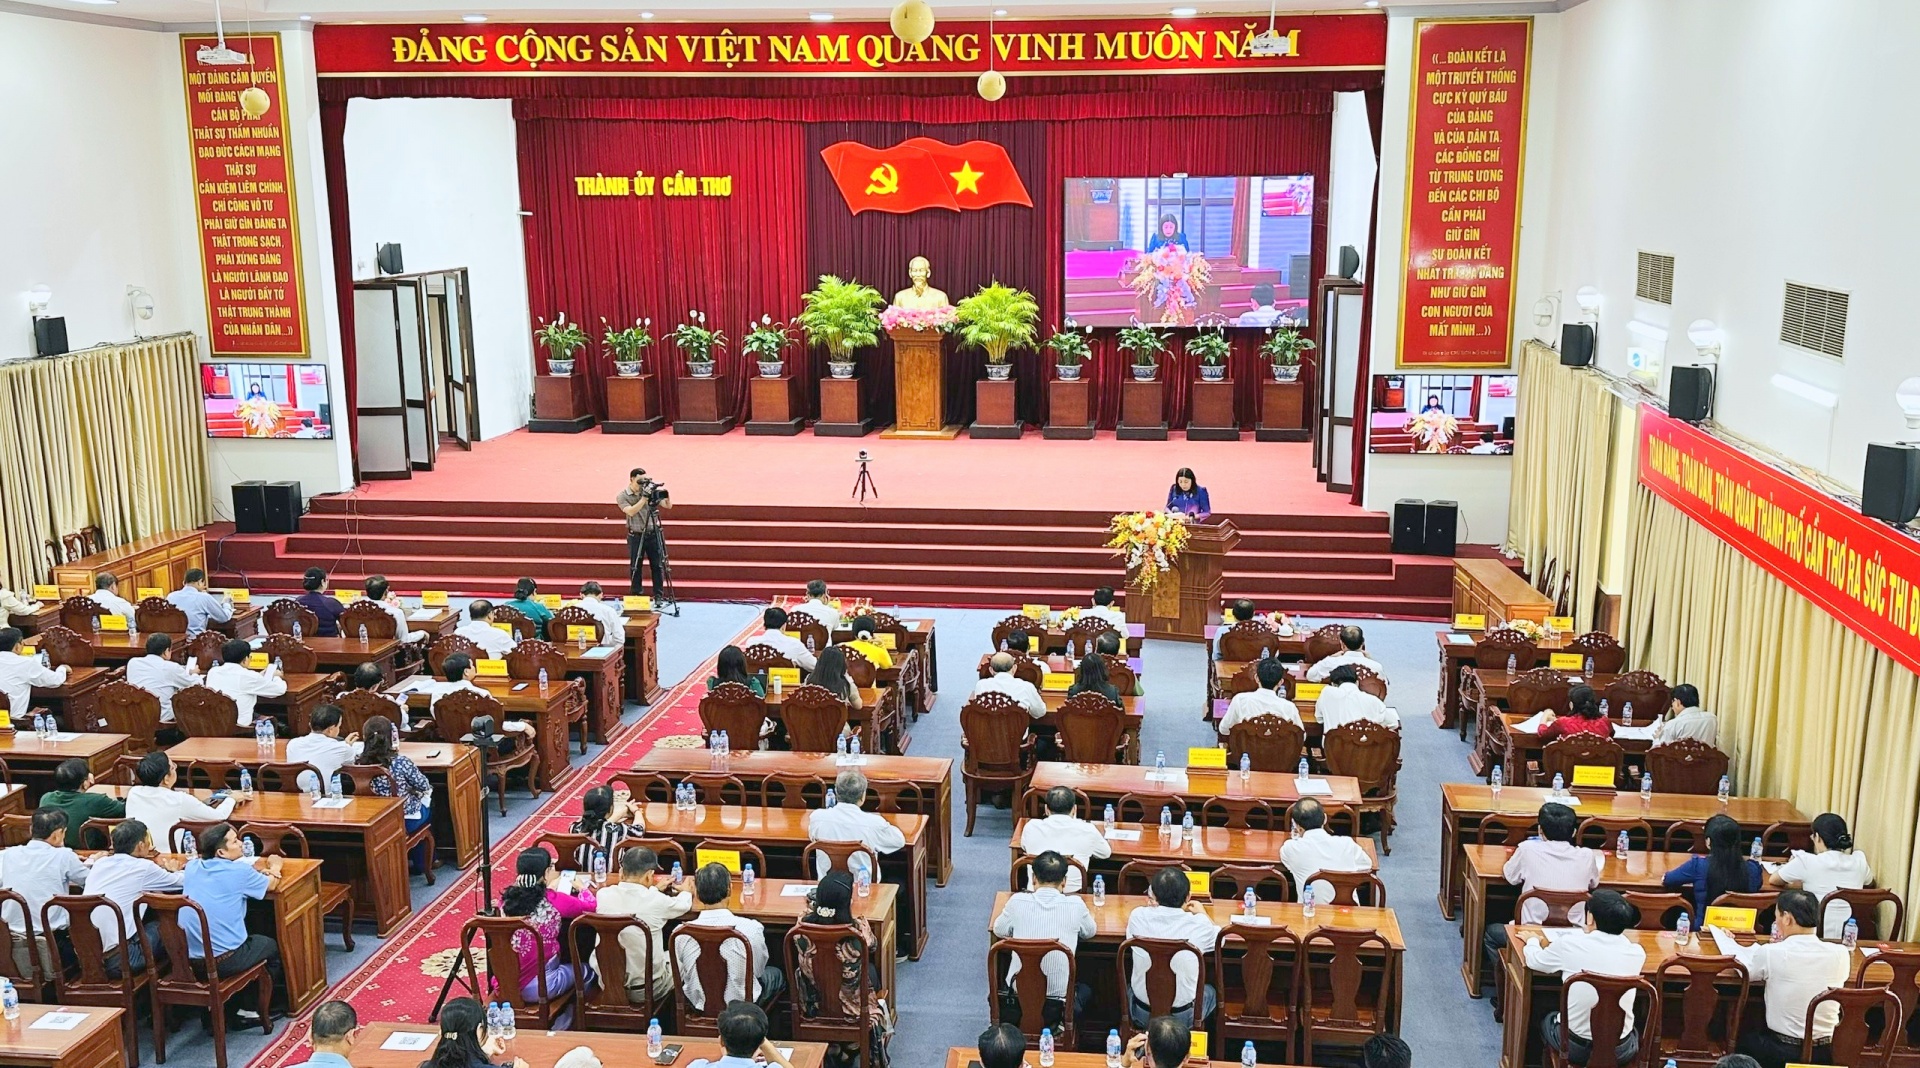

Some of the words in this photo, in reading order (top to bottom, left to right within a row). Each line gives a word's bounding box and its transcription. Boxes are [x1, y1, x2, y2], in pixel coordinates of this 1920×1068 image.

[391, 27, 487, 63] ĐẢNG
[494, 28, 594, 68] CỘNG
[600, 26, 668, 63] SẢN
[676, 28, 762, 68] VIỆT
[768, 35, 850, 63] NAM
[856, 34, 981, 68] QUANG
[992, 33, 1086, 61] VINH
[1094, 24, 1205, 60] MUÔN
[1475, 45, 1492, 63] KẾT
[1494, 47, 1506, 63] LÀ
[189, 70, 206, 87] MỘT
[208, 68, 230, 84] ĐẢNG
[230, 67, 249, 84] CẦM
[1426, 69, 1446, 87] MỘT
[1447, 67, 1483, 85] TRUYỀN
[1486, 66, 1516, 84] THỐNG
[215, 88, 236, 102] ĐẢNG
[1433, 91, 1453, 107] CỰC
[1469, 87, 1487, 105] QUÝ
[1490, 87, 1508, 103] BÁU
[211, 107, 228, 121] CÁN
[230, 107, 240, 123] BỘ
[1447, 107, 1466, 124] CỦA
[1467, 106, 1493, 123] ĐẢNG
[194, 127, 213, 141] THẬT
[215, 128, 225, 141] SỰ
[228, 123, 250, 139] THẤM
[1433, 129, 1445, 145] VÀ
[1446, 128, 1465, 144] CỦA
[1467, 128, 1487, 143] DÂN
[199, 146, 214, 160] ĐẠO
[215, 143, 233, 158] ĐỨC
[234, 143, 255, 158] CÁCH
[257, 144, 281, 160] MẠNG
[1435, 147, 1454, 164] CÁC
[1456, 145, 1482, 163] ĐỒNG
[1483, 146, 1500, 162] CHÍ
[225, 162, 244, 178] THẬT
[245, 163, 257, 178] SỰ
[1429, 168, 1441, 184] TỪ
[1443, 170, 1474, 184] TRUNG
[1475, 169, 1503, 182] ƯƠNG
[200, 178, 216, 194] CẦN
[217, 180, 237, 196] KIỆM
[239, 180, 257, 194] LIÊM
[259, 179, 286, 194] CHÍNH,
[574, 172, 629, 196] THÀNH
[633, 170, 655, 196] ỦY
[662, 170, 698, 196] CẦN
[700, 175, 732, 196] THƠ
[1428, 186, 1447, 203] ĐẾN
[1449, 187, 1468, 202] CÁC
[1469, 189, 1486, 202] CHI
[1487, 186, 1499, 204] BỘ
[213, 198, 226, 212] CHÍ
[228, 198, 250, 212] CÔNG
[251, 197, 262, 212] VÔ
[262, 200, 274, 212] TƯ
[1441, 205, 1461, 222] CẦN
[1463, 205, 1486, 221] PHẢI
[204, 216, 223, 230] PHẢI
[224, 216, 238, 230] GIỮ
[239, 216, 253, 229] GÌN
[254, 215, 276, 229] ĐẢNG
[277, 218, 287, 229] TA
[212, 234, 232, 249] THẬT
[233, 236, 258, 248] TRONG
[1445, 227, 1462, 242] GIỮ
[1463, 225, 1480, 241] GÌN
[216, 251, 235, 265] PHẢI
[236, 251, 259, 265] XỨNG
[1446, 246, 1472, 260] ĐOÀN
[1473, 243, 1491, 260] KẾT
[212, 269, 222, 283] LÀ
[223, 269, 249, 283] NGƯỜI
[250, 269, 272, 283] LÃNH
[273, 271, 288, 285] ĐẠO
[1417, 263, 1440, 280] NHẤT
[220, 287, 230, 300] LÀ
[231, 286, 257, 300] NGƯỜI
[1430, 285, 1452, 299] NHƯ
[1452, 285, 1469, 298] GIỮ
[1470, 283, 1486, 298] GÌN
[217, 304, 237, 319] THẬT
[238, 306, 264, 318] TRUNG
[264, 304, 291, 318] THÀNH
[1421, 305, 1440, 318] CON
[1474, 302, 1493, 317] CỦA
[223, 321, 240, 335] CỦA
[241, 322, 262, 335] NHÂN
[1682, 448, 1698, 497] TOÀN
[1698, 456, 1713, 514] DÂN,
[1715, 466, 1735, 519] TOÀN
[1735, 480, 1756, 534] QUÂN
[1757, 492, 1785, 551] THÀNH
[1785, 506, 1806, 563] PHỐ
[1804, 512, 1826, 577] CẦN
[1826, 536, 1848, 591] THƠ
[1846, 548, 1861, 602] RA
[1863, 549, 1886, 617] SỨC
[1888, 571, 1909, 631] THI
[1909, 584, 1920, 642] Đ
